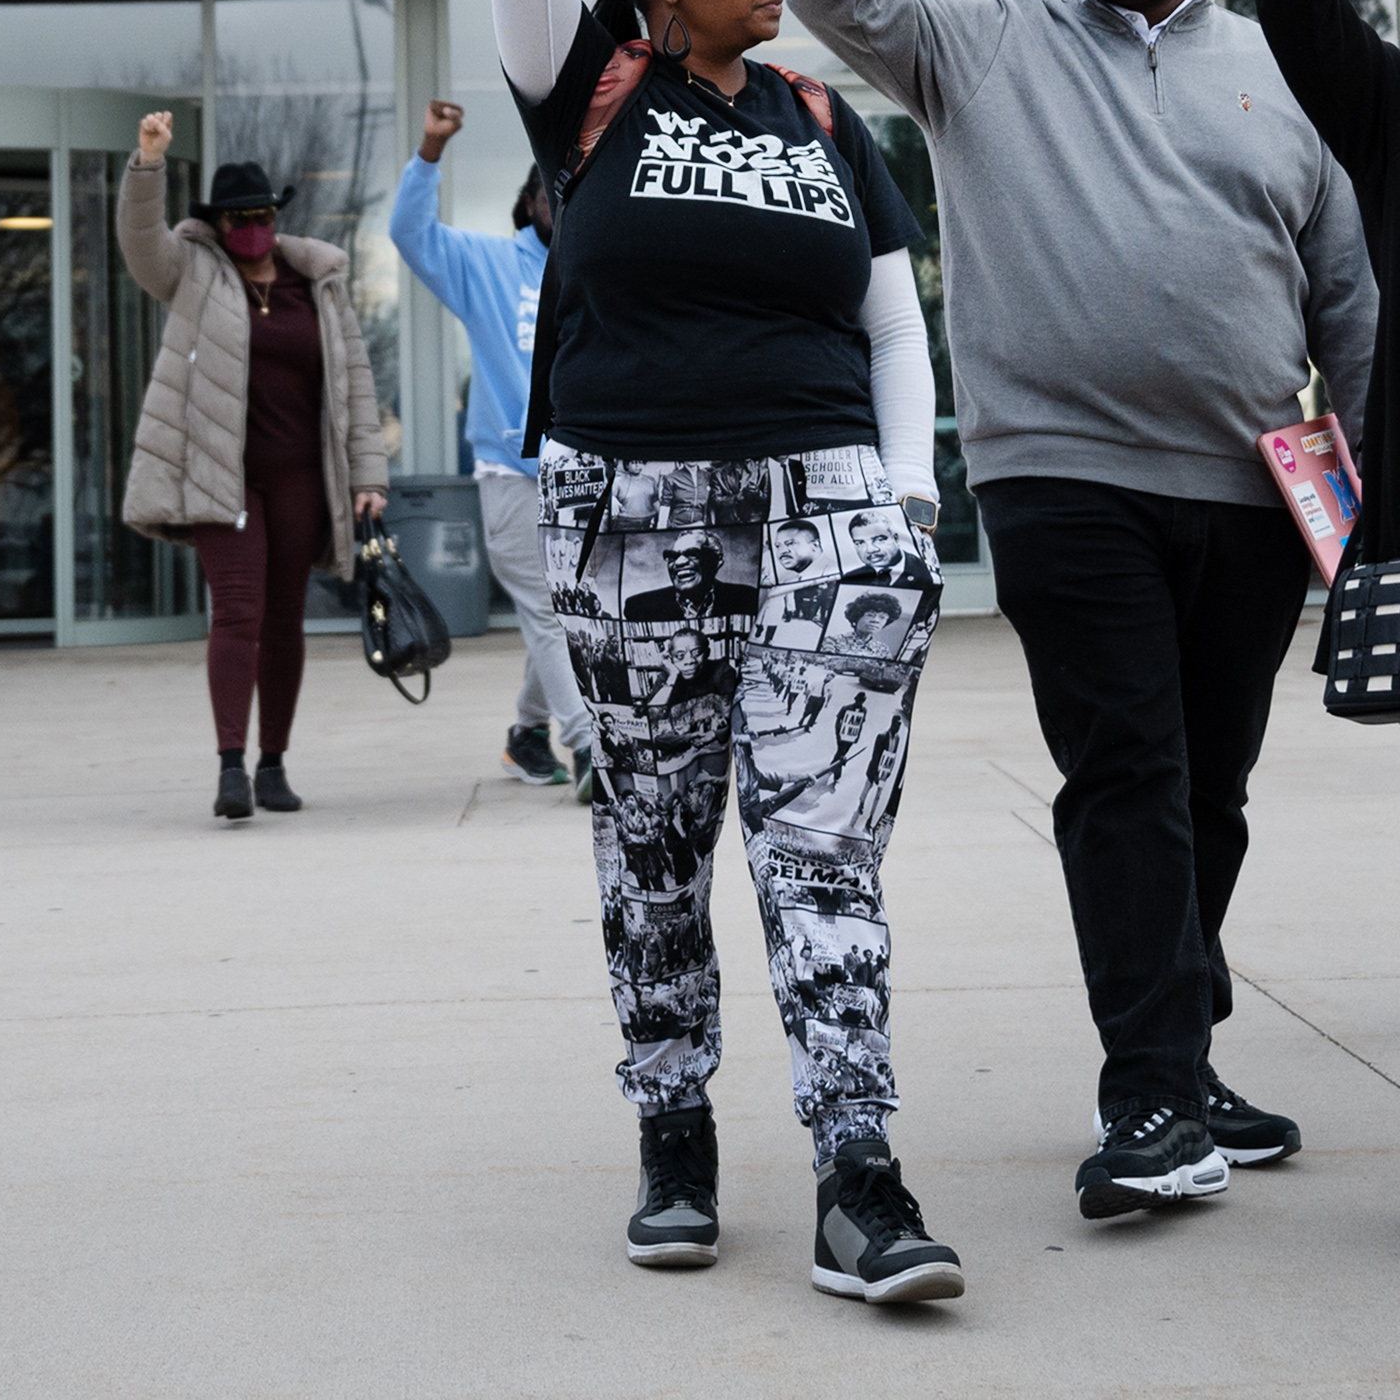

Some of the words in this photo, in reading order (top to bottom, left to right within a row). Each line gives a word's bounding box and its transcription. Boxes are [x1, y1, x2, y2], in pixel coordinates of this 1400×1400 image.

[635, 163, 748, 201] FULL
[762, 176, 850, 223] LIPS
[804, 449, 852, 462] BETTER
[804, 461, 854, 473] SCHOOLS
[564, 469, 591, 484] BLACK
[806, 473, 826, 485] FOR
[573, 480, 605, 497] MATTER
[768, 863, 867, 890] SELMA
